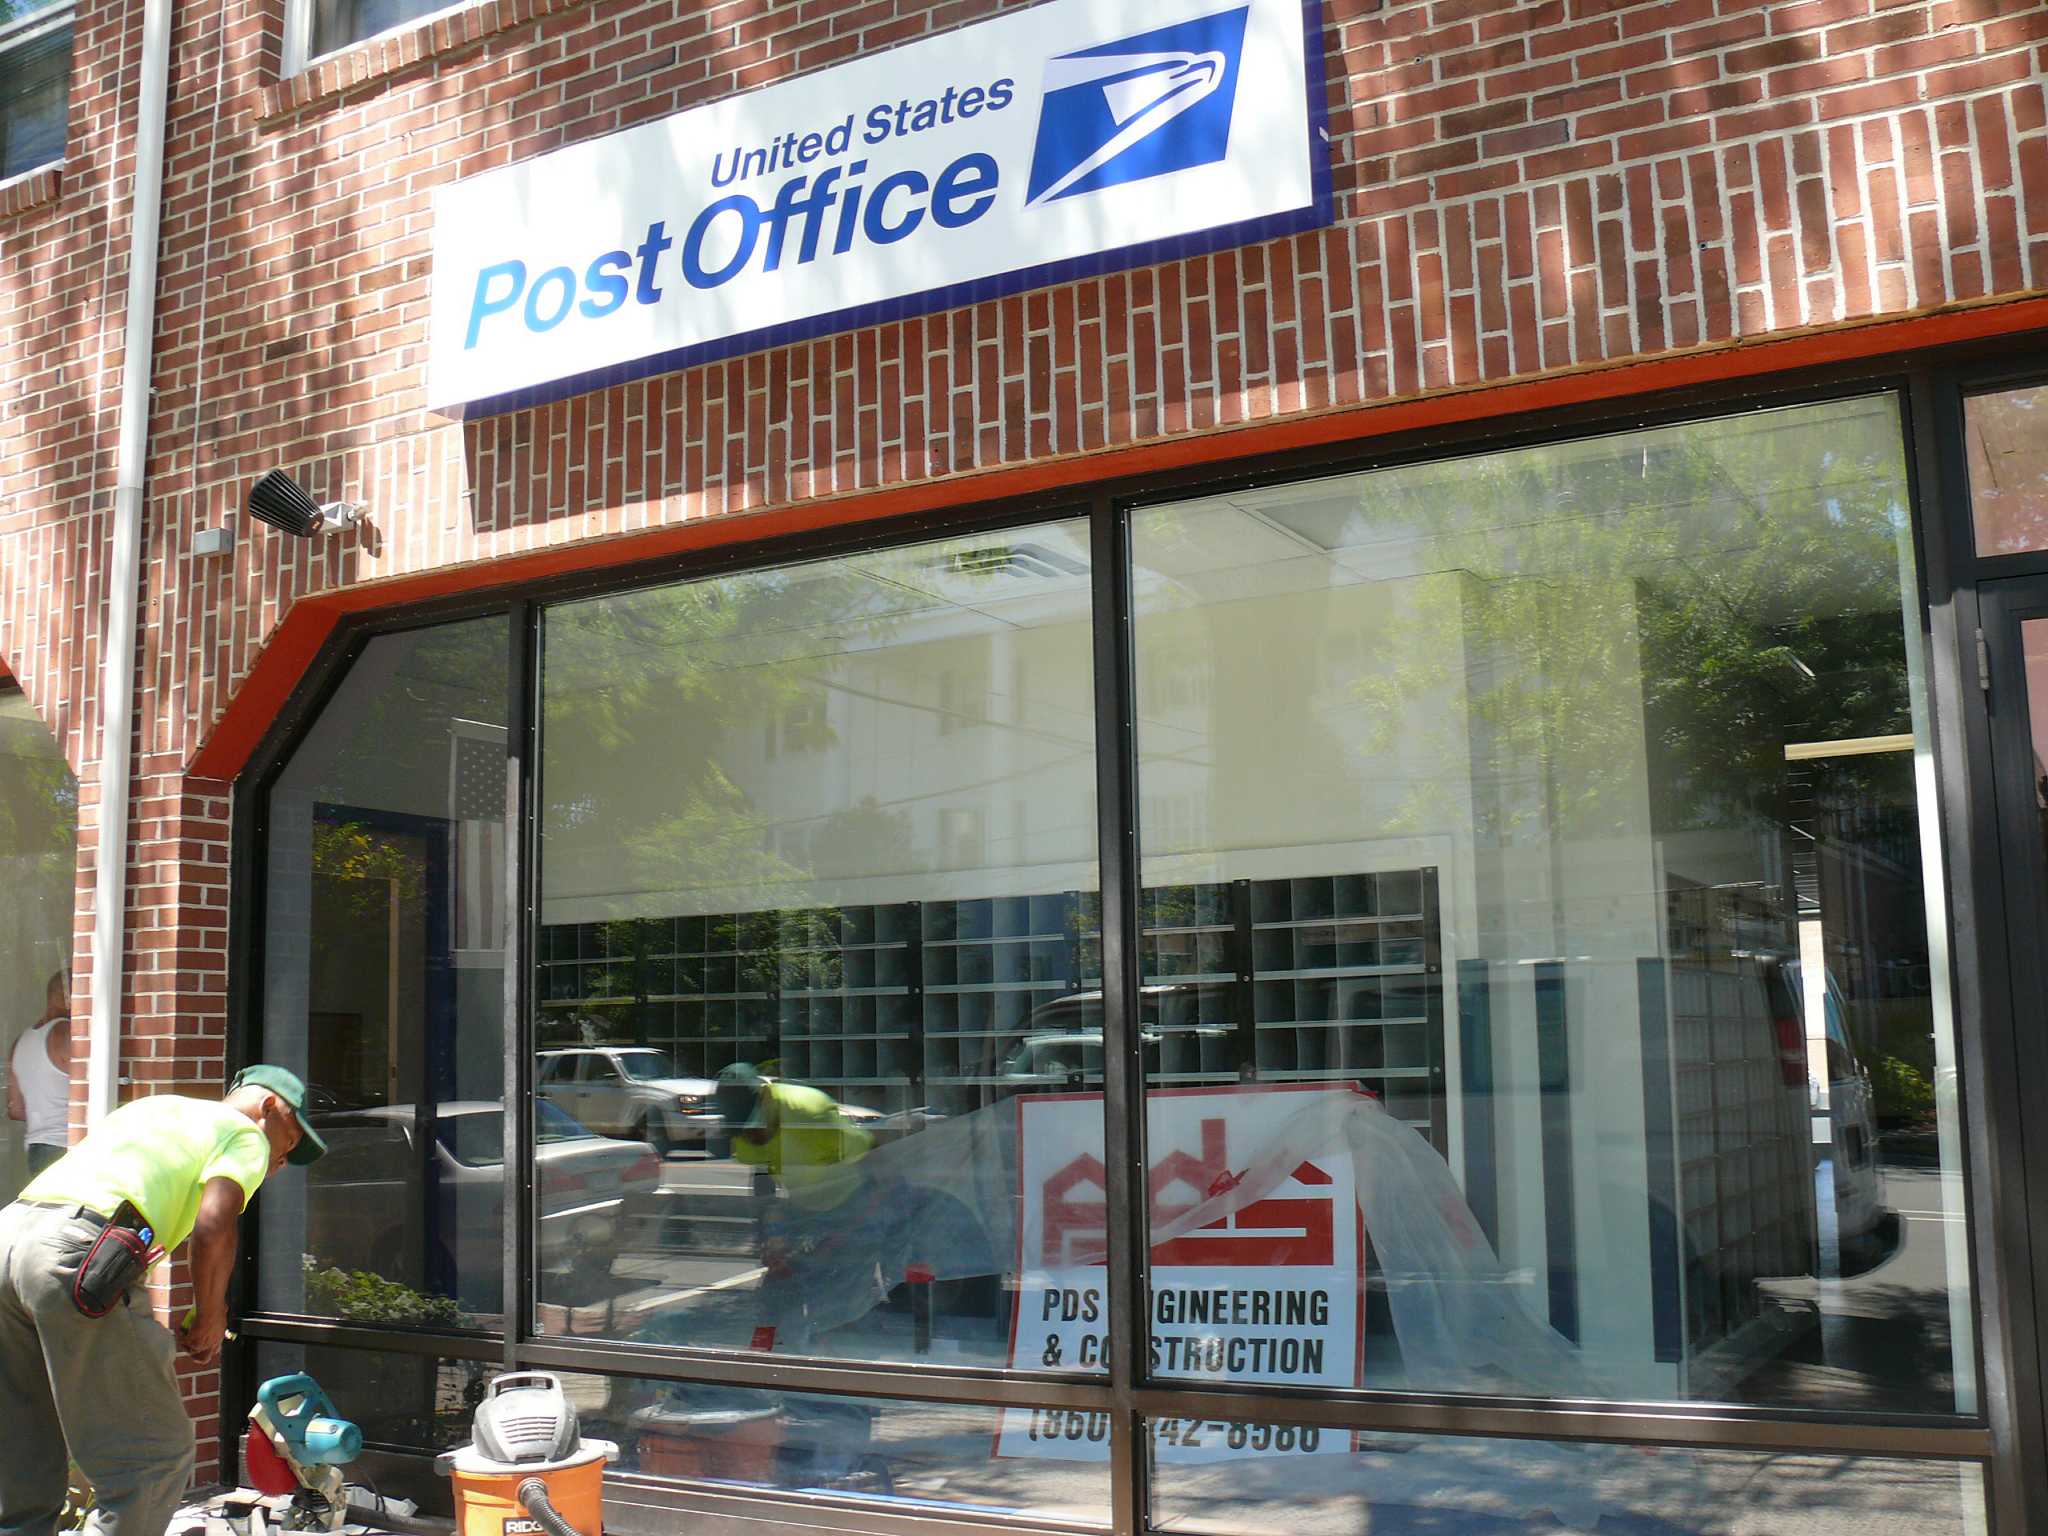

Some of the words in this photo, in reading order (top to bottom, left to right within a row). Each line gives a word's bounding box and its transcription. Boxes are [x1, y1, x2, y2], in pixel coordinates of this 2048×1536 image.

[711, 114, 855, 188] United
[863, 78, 1015, 145] States
[464, 220, 673, 351] Post
[681, 152, 1000, 290] Office
[1042, 1288, 1100, 1323] PDS
[1149, 1288, 1329, 1327] GINEERING
[1042, 1333, 1062, 1368] &
[1079, 1333, 1324, 1375] COSTRUCTION
[1028, 1408, 1112, 1447] (860
[505, 1520, 544, 1534] RIDG
